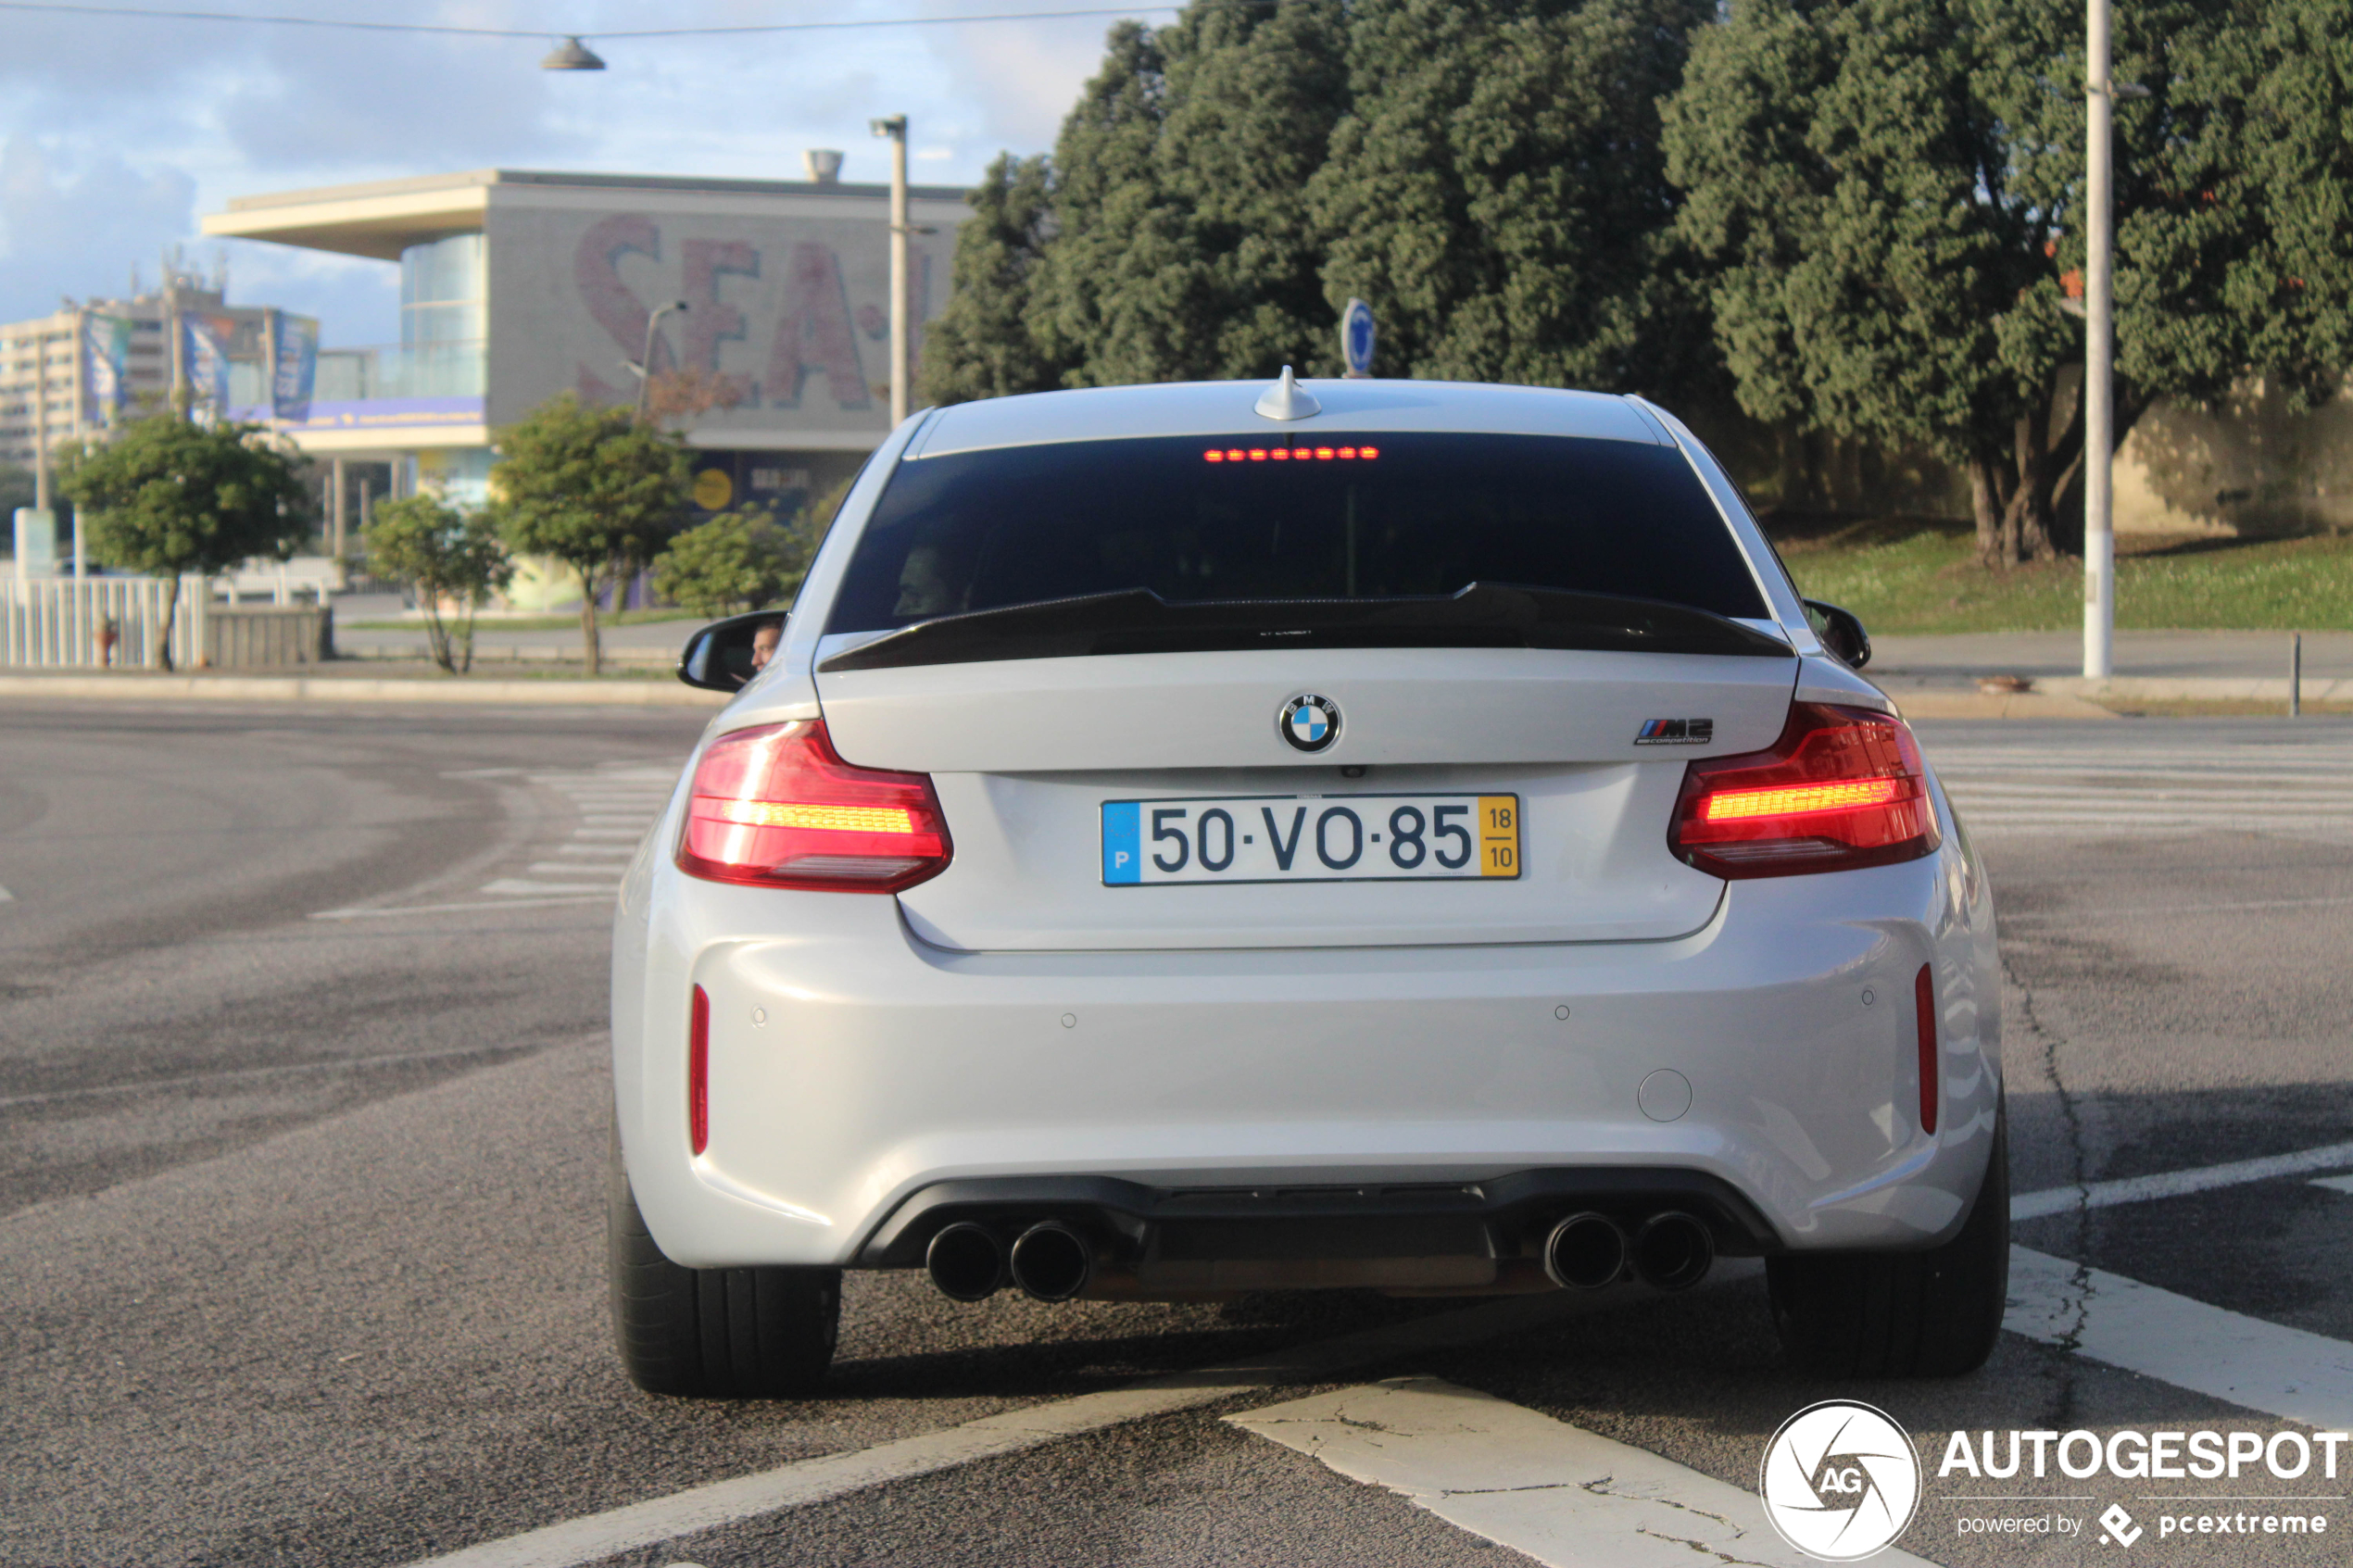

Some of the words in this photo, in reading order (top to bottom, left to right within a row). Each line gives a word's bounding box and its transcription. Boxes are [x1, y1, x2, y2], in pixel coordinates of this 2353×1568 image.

[1284, 695, 1335, 715] BMW
[1663, 719, 1713, 736] M2
[1649, 736, 1709, 745] competition
[1490, 808, 1512, 829] 18
[1114, 851, 1129, 869] P
[1491, 847, 1513, 868] 10
